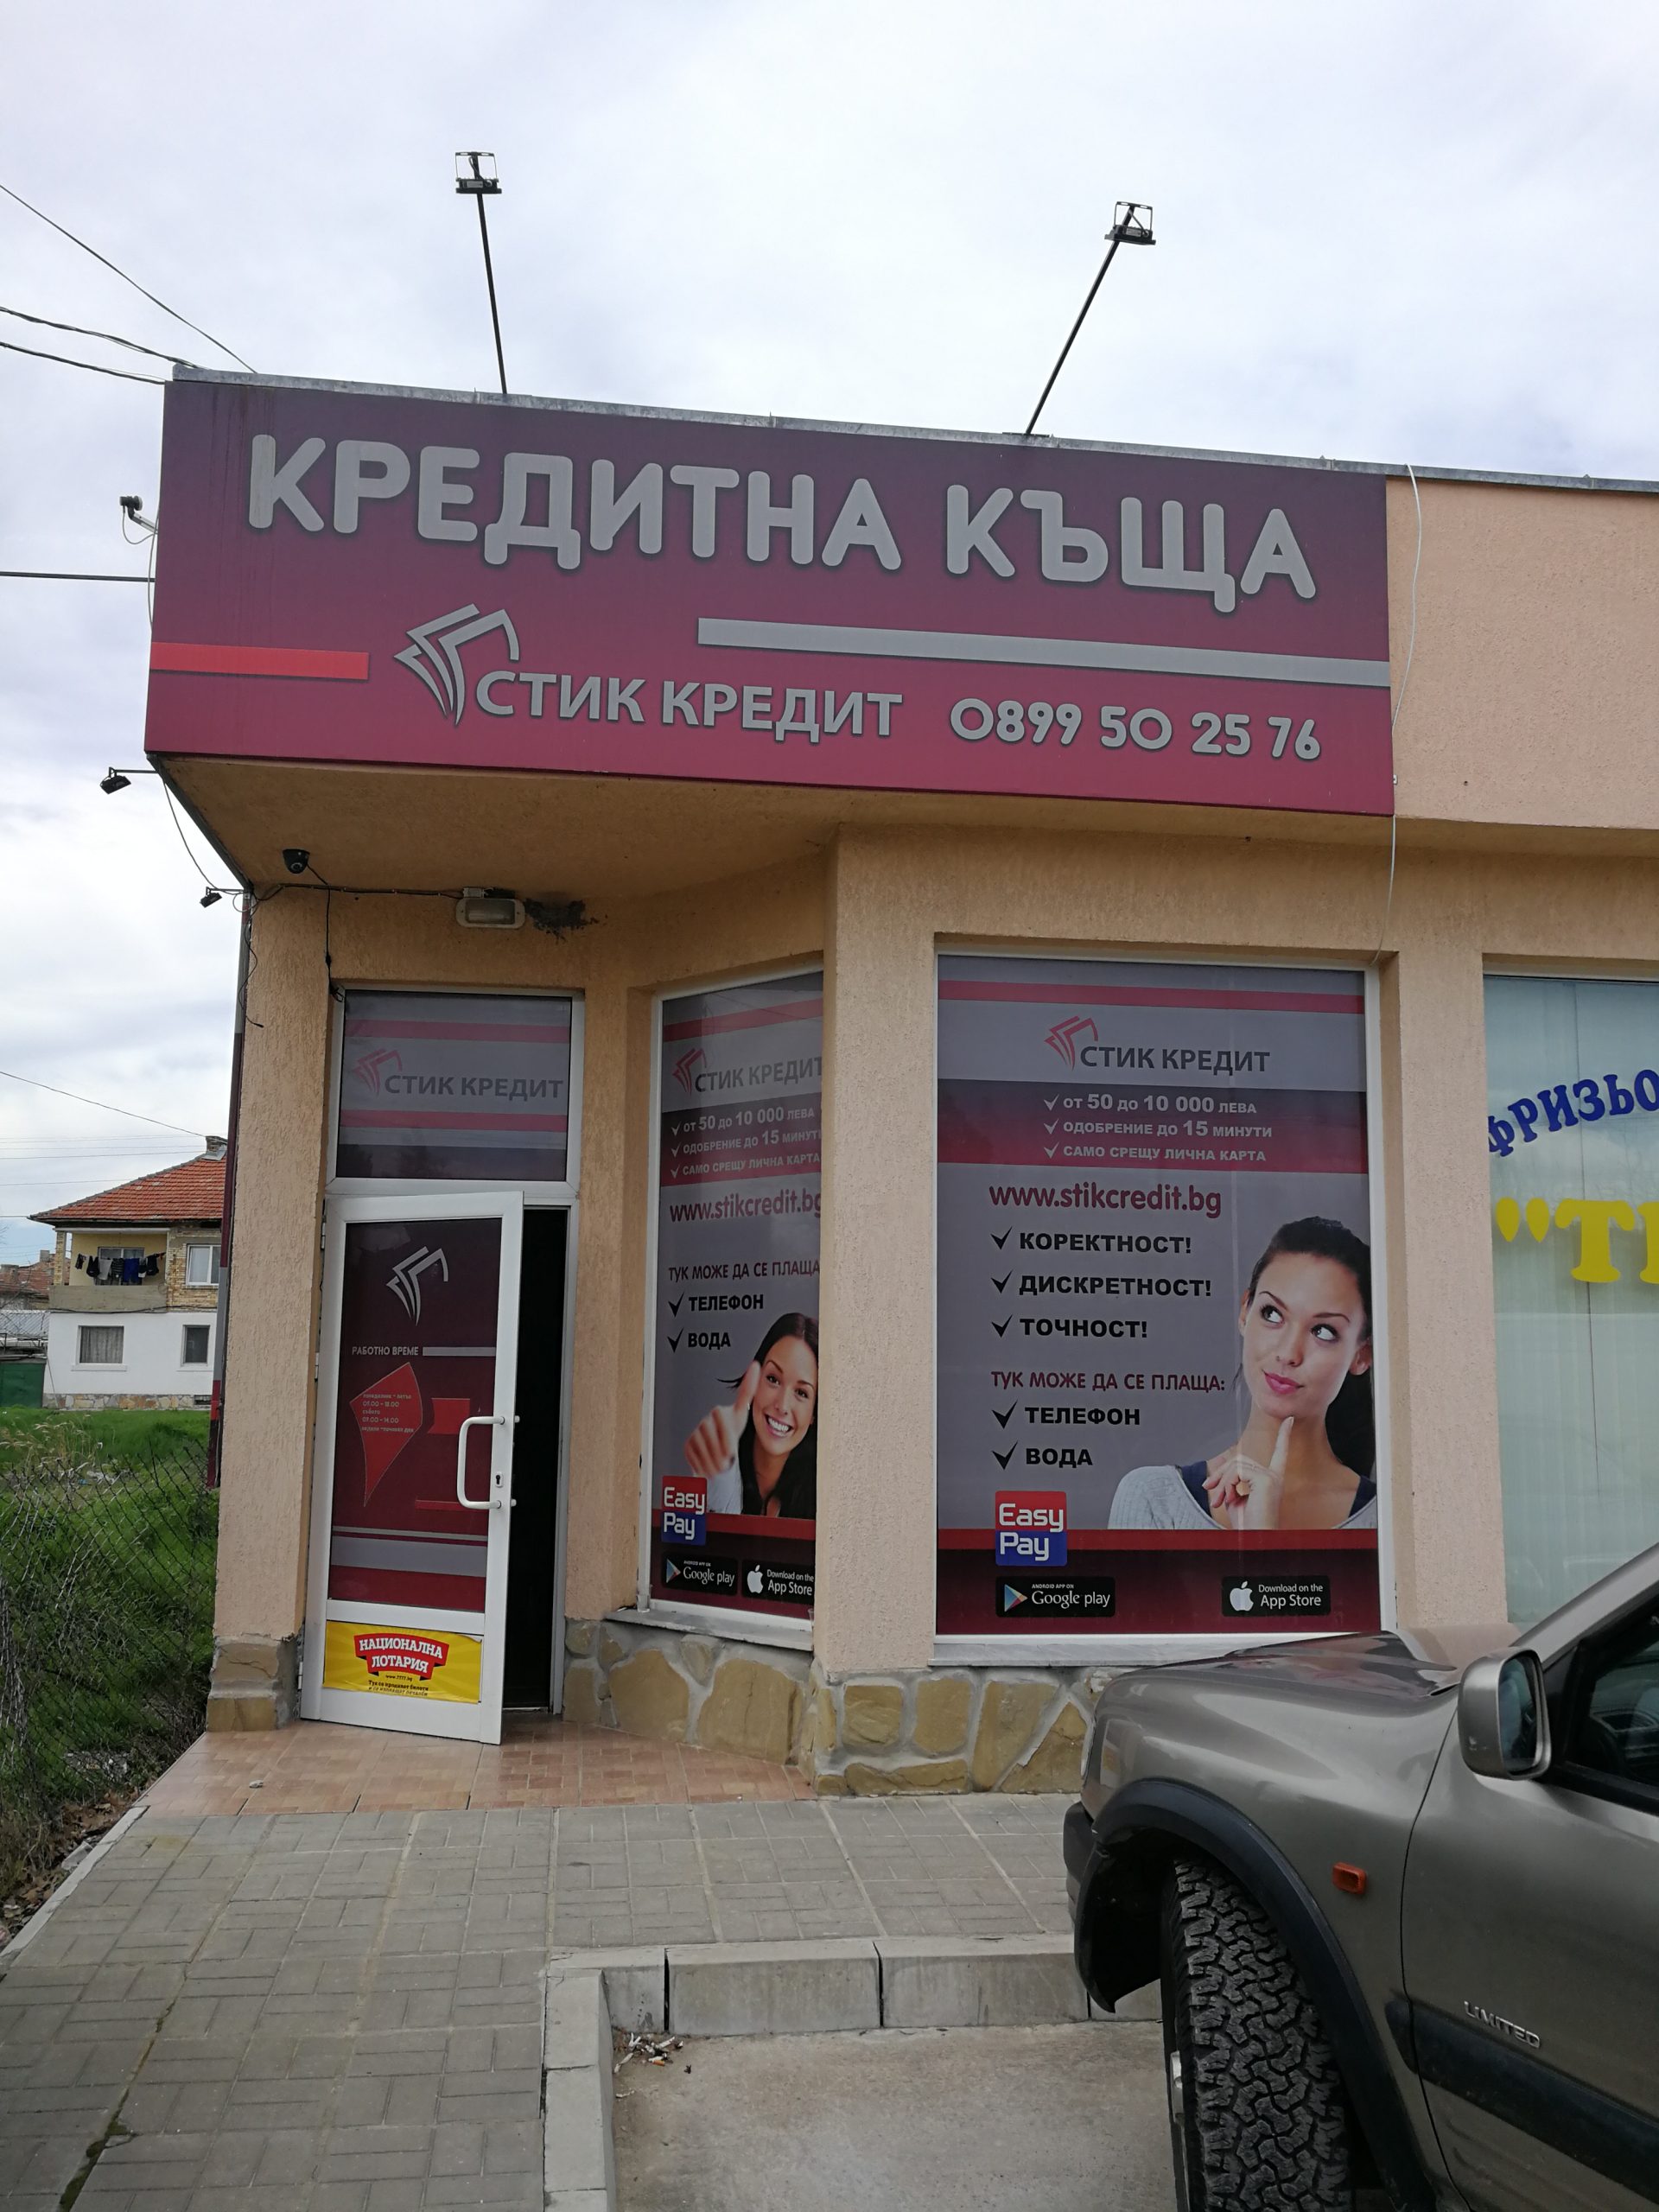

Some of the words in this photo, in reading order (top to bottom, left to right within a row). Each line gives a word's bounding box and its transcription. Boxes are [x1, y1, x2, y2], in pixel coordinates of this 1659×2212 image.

[248, 434, 901, 570] КРЕДИТНА
[947, 484, 1315, 613] КЪЩА
[476, 671, 645, 722] СТИК
[663, 680, 903, 743] КРЕДИТ
[950, 697, 1082, 745] 0899
[1101, 705, 1173, 750] 50
[1192, 713, 1252, 755] 25
[1268, 717, 1321, 760] 76
[1080, 1046, 1154, 1069] СТИК
[1163, 1049, 1270, 1076] КРЕДИТ
[695, 1068, 744, 1093] СТИК
[749, 1056, 823, 1085] КРЕДИТ
[385, 1075, 454, 1096] СТИК
[461, 1077, 563, 1102] КРЕДИТ
[1087, 1094, 1113, 1110] 50
[1144, 1096, 1168, 1112] 10
[1176, 1096, 1215, 1113] 000
[1218, 1103, 1256, 1114] ЛЕВА
[698, 1116, 715, 1130] 50
[735, 1110, 753, 1126] 10
[757, 1107, 785, 1123] 000
[787, 1108, 815, 1121] ЛЕВА
[1064, 1122, 1153, 1135] ОДОБРЕНИЕ
[1183, 1120, 1209, 1136] 15
[1213, 1127, 1272, 1138] МИНУТИ
[683, 1138, 741, 1154] ОДОБРЕНИЕ
[762, 1129, 779, 1146] 15
[1064, 1146, 1105, 1157] САМО
[1109, 1147, 1160, 1159] СРЕЩУ
[1165, 1149, 1216, 1160] ЛИЧНА
[1219, 1150, 1266, 1161] КАРТА
[683, 1163, 709, 1176] САМО
[712, 1160, 747, 1173] СРЕЩУ
[749, 1157, 784, 1169] ЛИЧНА
[786, 1154, 820, 1165] КАРТА
[989, 1182, 1221, 1218] www.stikcredit.bg
[1020, 1232, 1192, 1254] КОРЕКТНОСТ!
[669, 1267, 689, 1282] ТУК
[692, 1264, 728, 1280] МОЖЕ
[733, 1263, 749, 1281] ДА
[753, 1262, 767, 1277] СЕ
[1019, 1275, 1211, 1296] ДИСКРЕТНОСТ!
[689, 1294, 764, 1312] ТЕЛЕФОН
[1020, 1319, 1147, 1338] ТОЧНОСТ!
[352, 1346, 390, 1356] РАБОТНО
[392, 1346, 419, 1356] ВРЕМЕ
[688, 1332, 731, 1350] ВОДА
[991, 1371, 1024, 1391] ТУК
[1030, 1372, 1085, 1389] МОЖЕ
[1093, 1374, 1117, 1390] ДА
[1124, 1374, 1145, 1390] СЕ
[1151, 1375, 1225, 1394] ПЛАЩА:
[1025, 1407, 1141, 1426] ТЕЛЕФОН
[1025, 1448, 1093, 1468] ВОДА
[664, 1486, 705, 1515] Easy
[664, 1512, 695, 1540] Pay
[999, 1503, 1064, 1532] Easy
[1000, 1532, 1050, 1561] Pay
[683, 1567, 714, 1585] Google
[717, 1571, 734, 1587] play
[766, 1569, 796, 1580] Download
[804, 1572, 814, 1582] the
[768, 1580, 787, 1595] App
[789, 1581, 812, 1596] Store
[1258, 1584, 1297, 1592] Download
[1311, 1583, 1323, 1592] the
[1032, 1590, 1080, 1609] Google
[1084, 1591, 1110, 1607] play
[1261, 1594, 1287, 1609] App
[1289, 1594, 1321, 1606] Store
[359, 1637, 443, 1659] НАЦИОНАЛНА
[372, 1656, 429, 1674] ЛОТАРИЯ
[1464, 2000, 1540, 2049] LIMITED
